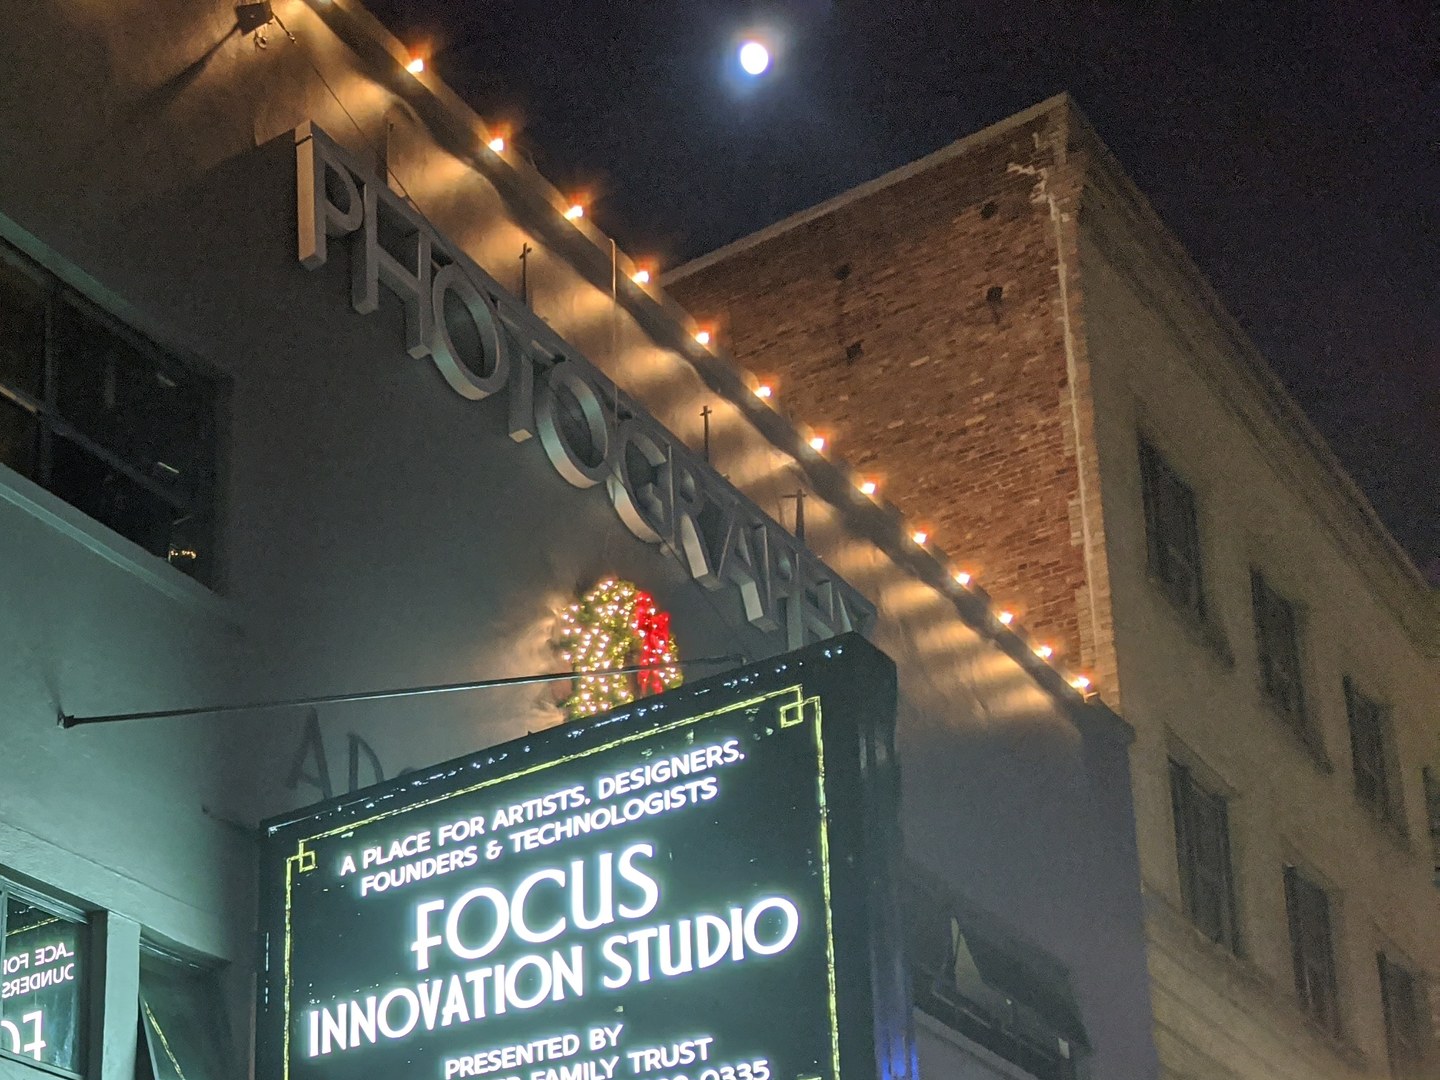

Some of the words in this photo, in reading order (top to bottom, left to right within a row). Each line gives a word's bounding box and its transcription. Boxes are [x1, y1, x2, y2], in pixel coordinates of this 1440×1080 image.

[340, 854, 357, 877] A
[362, 831, 432, 869] PLACE
[438, 816, 485, 846] FOR
[361, 846, 478, 897] FOUNDERS
[486, 839, 503, 860] &
[509, 777, 719, 853] TECHNOLOGISTS
[409, 843, 661, 972] FOCUS
[308, 945, 585, 1058] INNOVATION
[602, 897, 800, 989] STUDIO
[444, 1034, 580, 1080] PRESENTED
[589, 1025, 624, 1051] BY
[627, 1037, 714, 1074] TRUST
